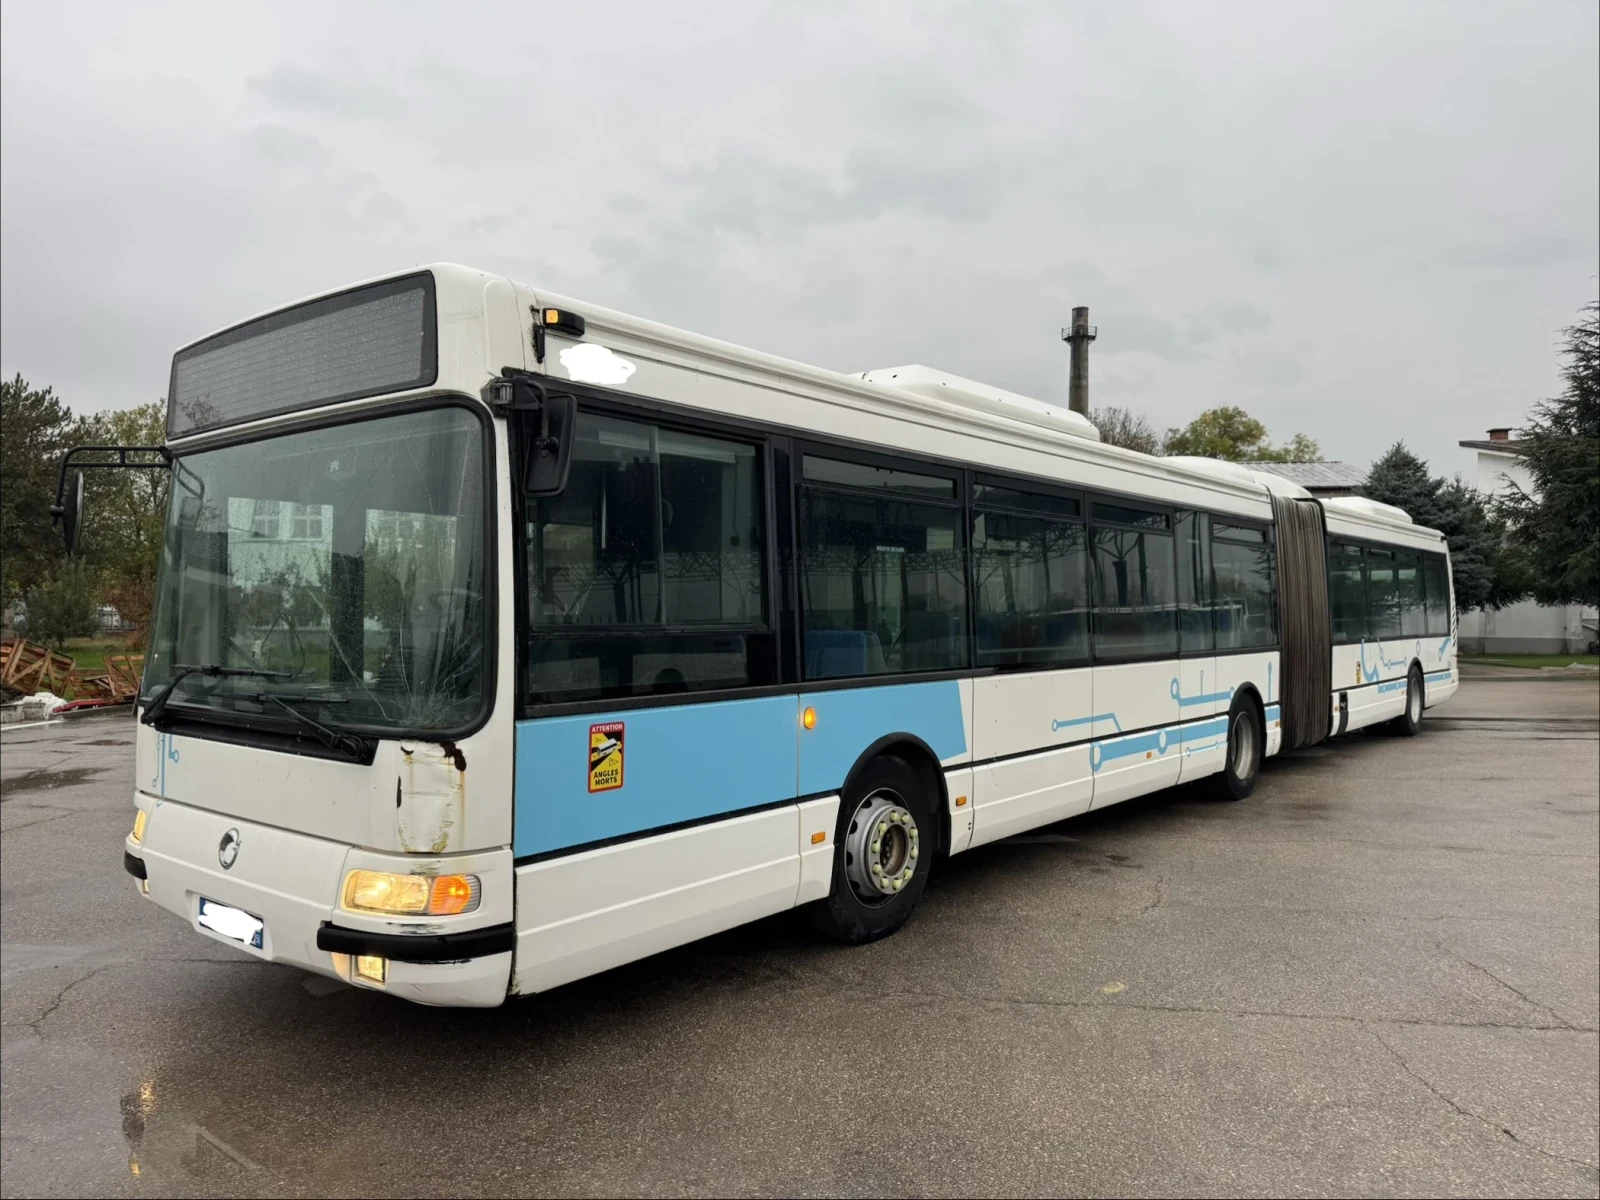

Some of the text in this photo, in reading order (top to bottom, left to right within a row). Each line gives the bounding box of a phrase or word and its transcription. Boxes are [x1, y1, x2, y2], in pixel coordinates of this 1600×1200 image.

[592, 723, 623, 732] ATTENTION
[594, 769, 618, 779] ANGLES
[595, 776, 617, 786] MORTS
